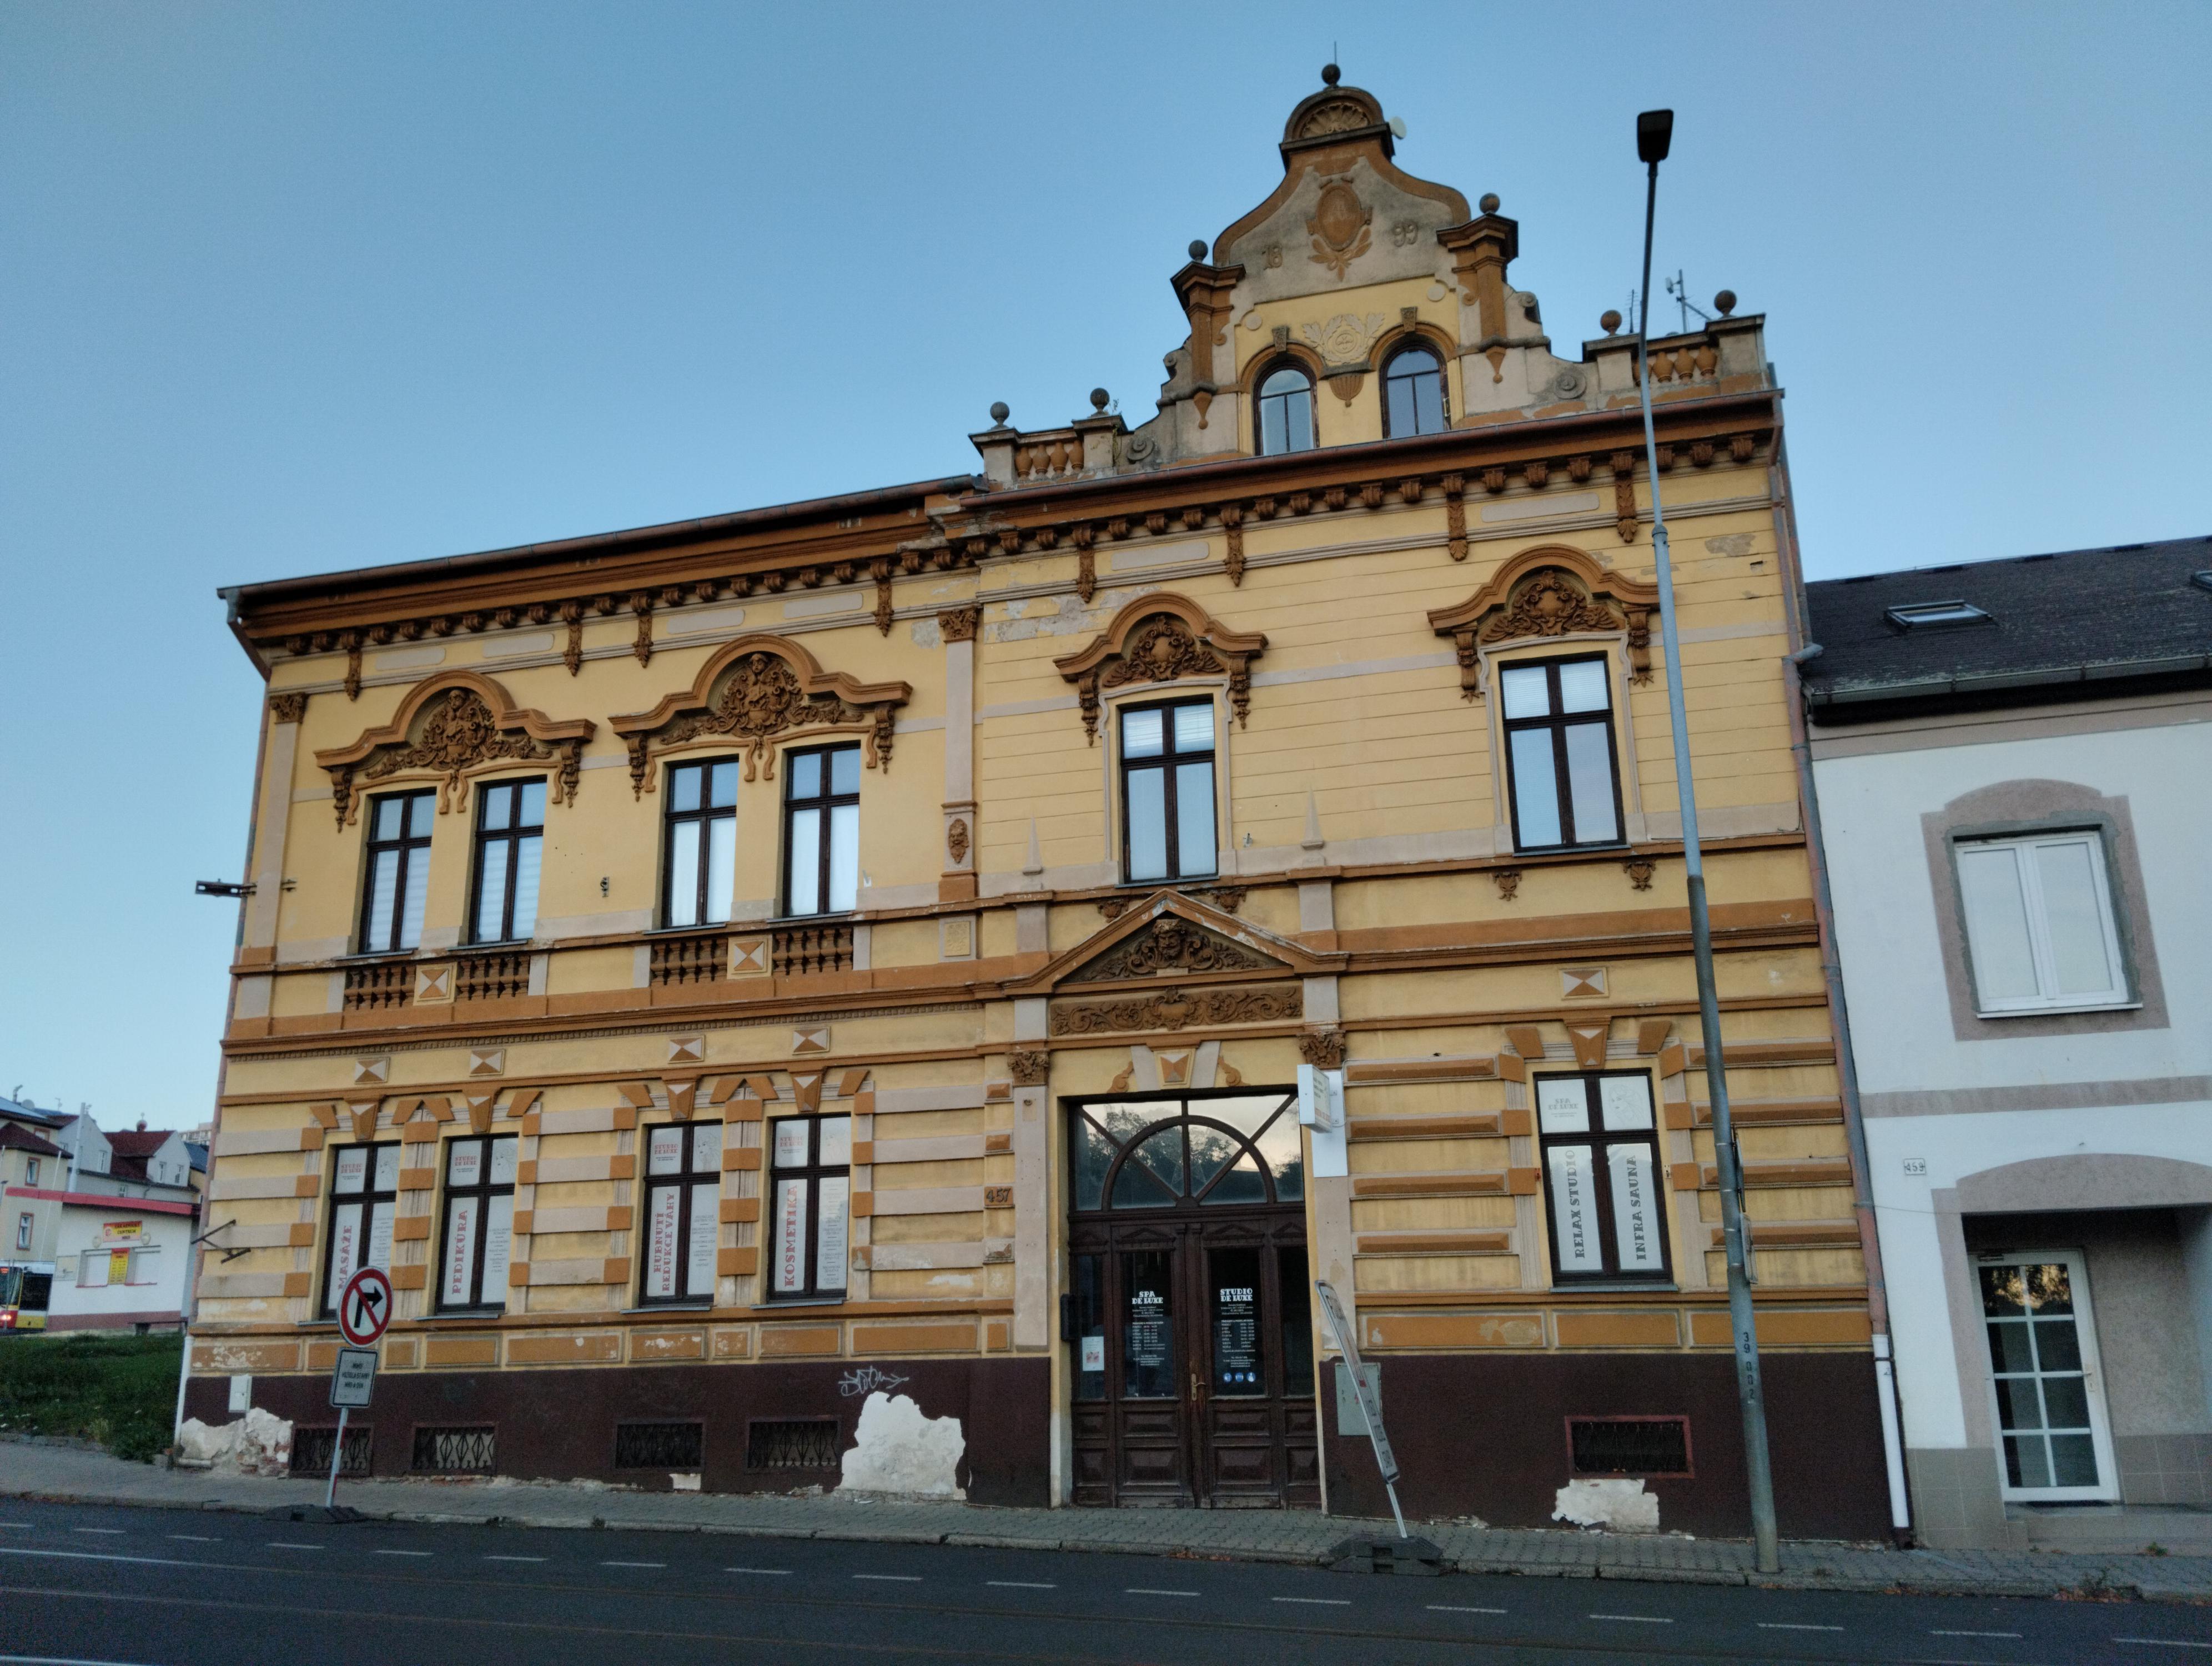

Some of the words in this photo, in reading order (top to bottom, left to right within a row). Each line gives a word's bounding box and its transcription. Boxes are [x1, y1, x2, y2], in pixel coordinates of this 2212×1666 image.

[1565, 1150, 1580, 1206] STUDIO
[1626, 1155, 1641, 1207] SAUNA
[665, 1193, 674, 1229] VÁHY
[785, 1185, 797, 1287] KOSMETIKA
[1571, 1210, 1585, 1258] RELAX
[1632, 1211, 1646, 1260] INFRA
[338, 1226, 351, 1289] MASÁŽE
[452, 1210, 467, 1294] PEDIKÚRA
[653, 1212, 664, 1273] HUBNUTÍ
[662, 1231, 672, 1291] REDUKCE
